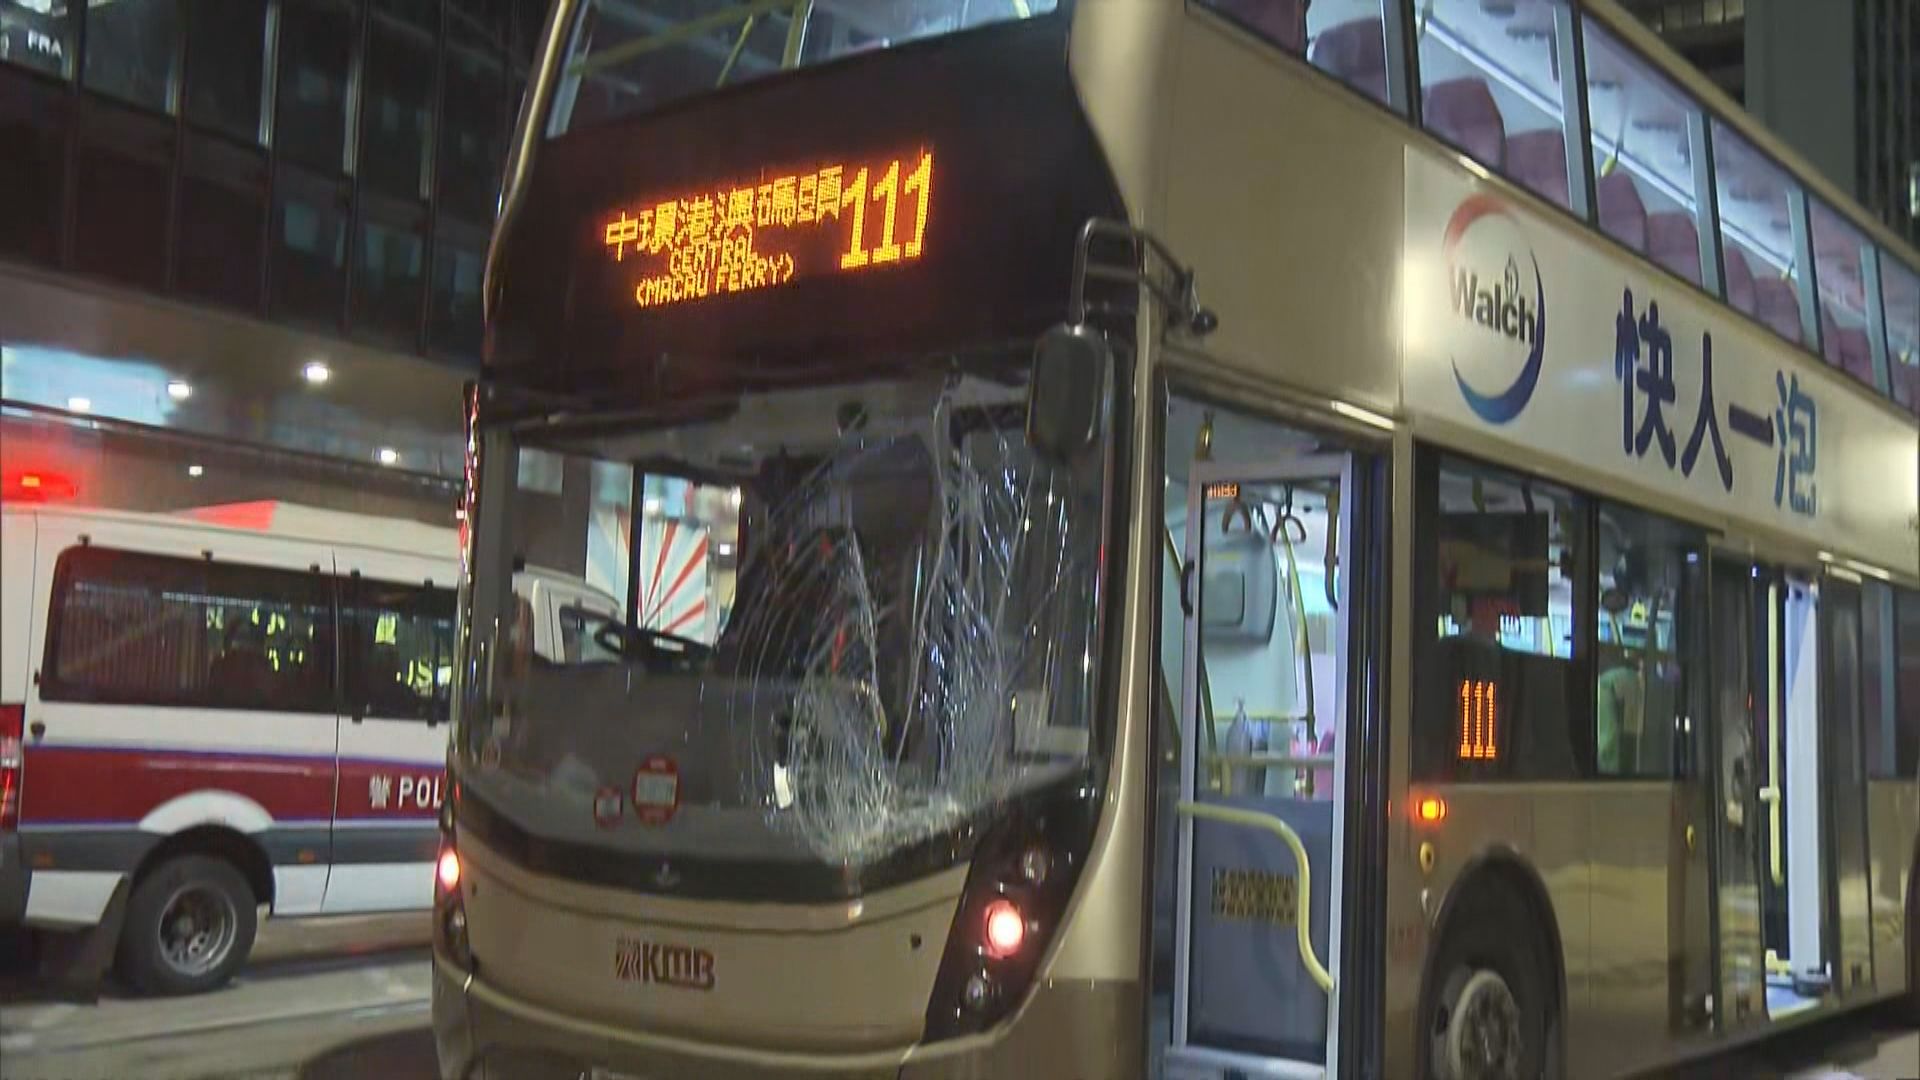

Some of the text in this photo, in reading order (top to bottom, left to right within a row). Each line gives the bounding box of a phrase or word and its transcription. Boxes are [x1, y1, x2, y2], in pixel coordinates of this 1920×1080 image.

[605, 153, 932, 269] 中環港澳碼頭 111
[669, 224, 753, 276] CENTRAL
[1449, 264, 1535, 345] Walch
[1615, 286, 1817, 517] 快人一泡
[1460, 679, 1496, 758] 111
